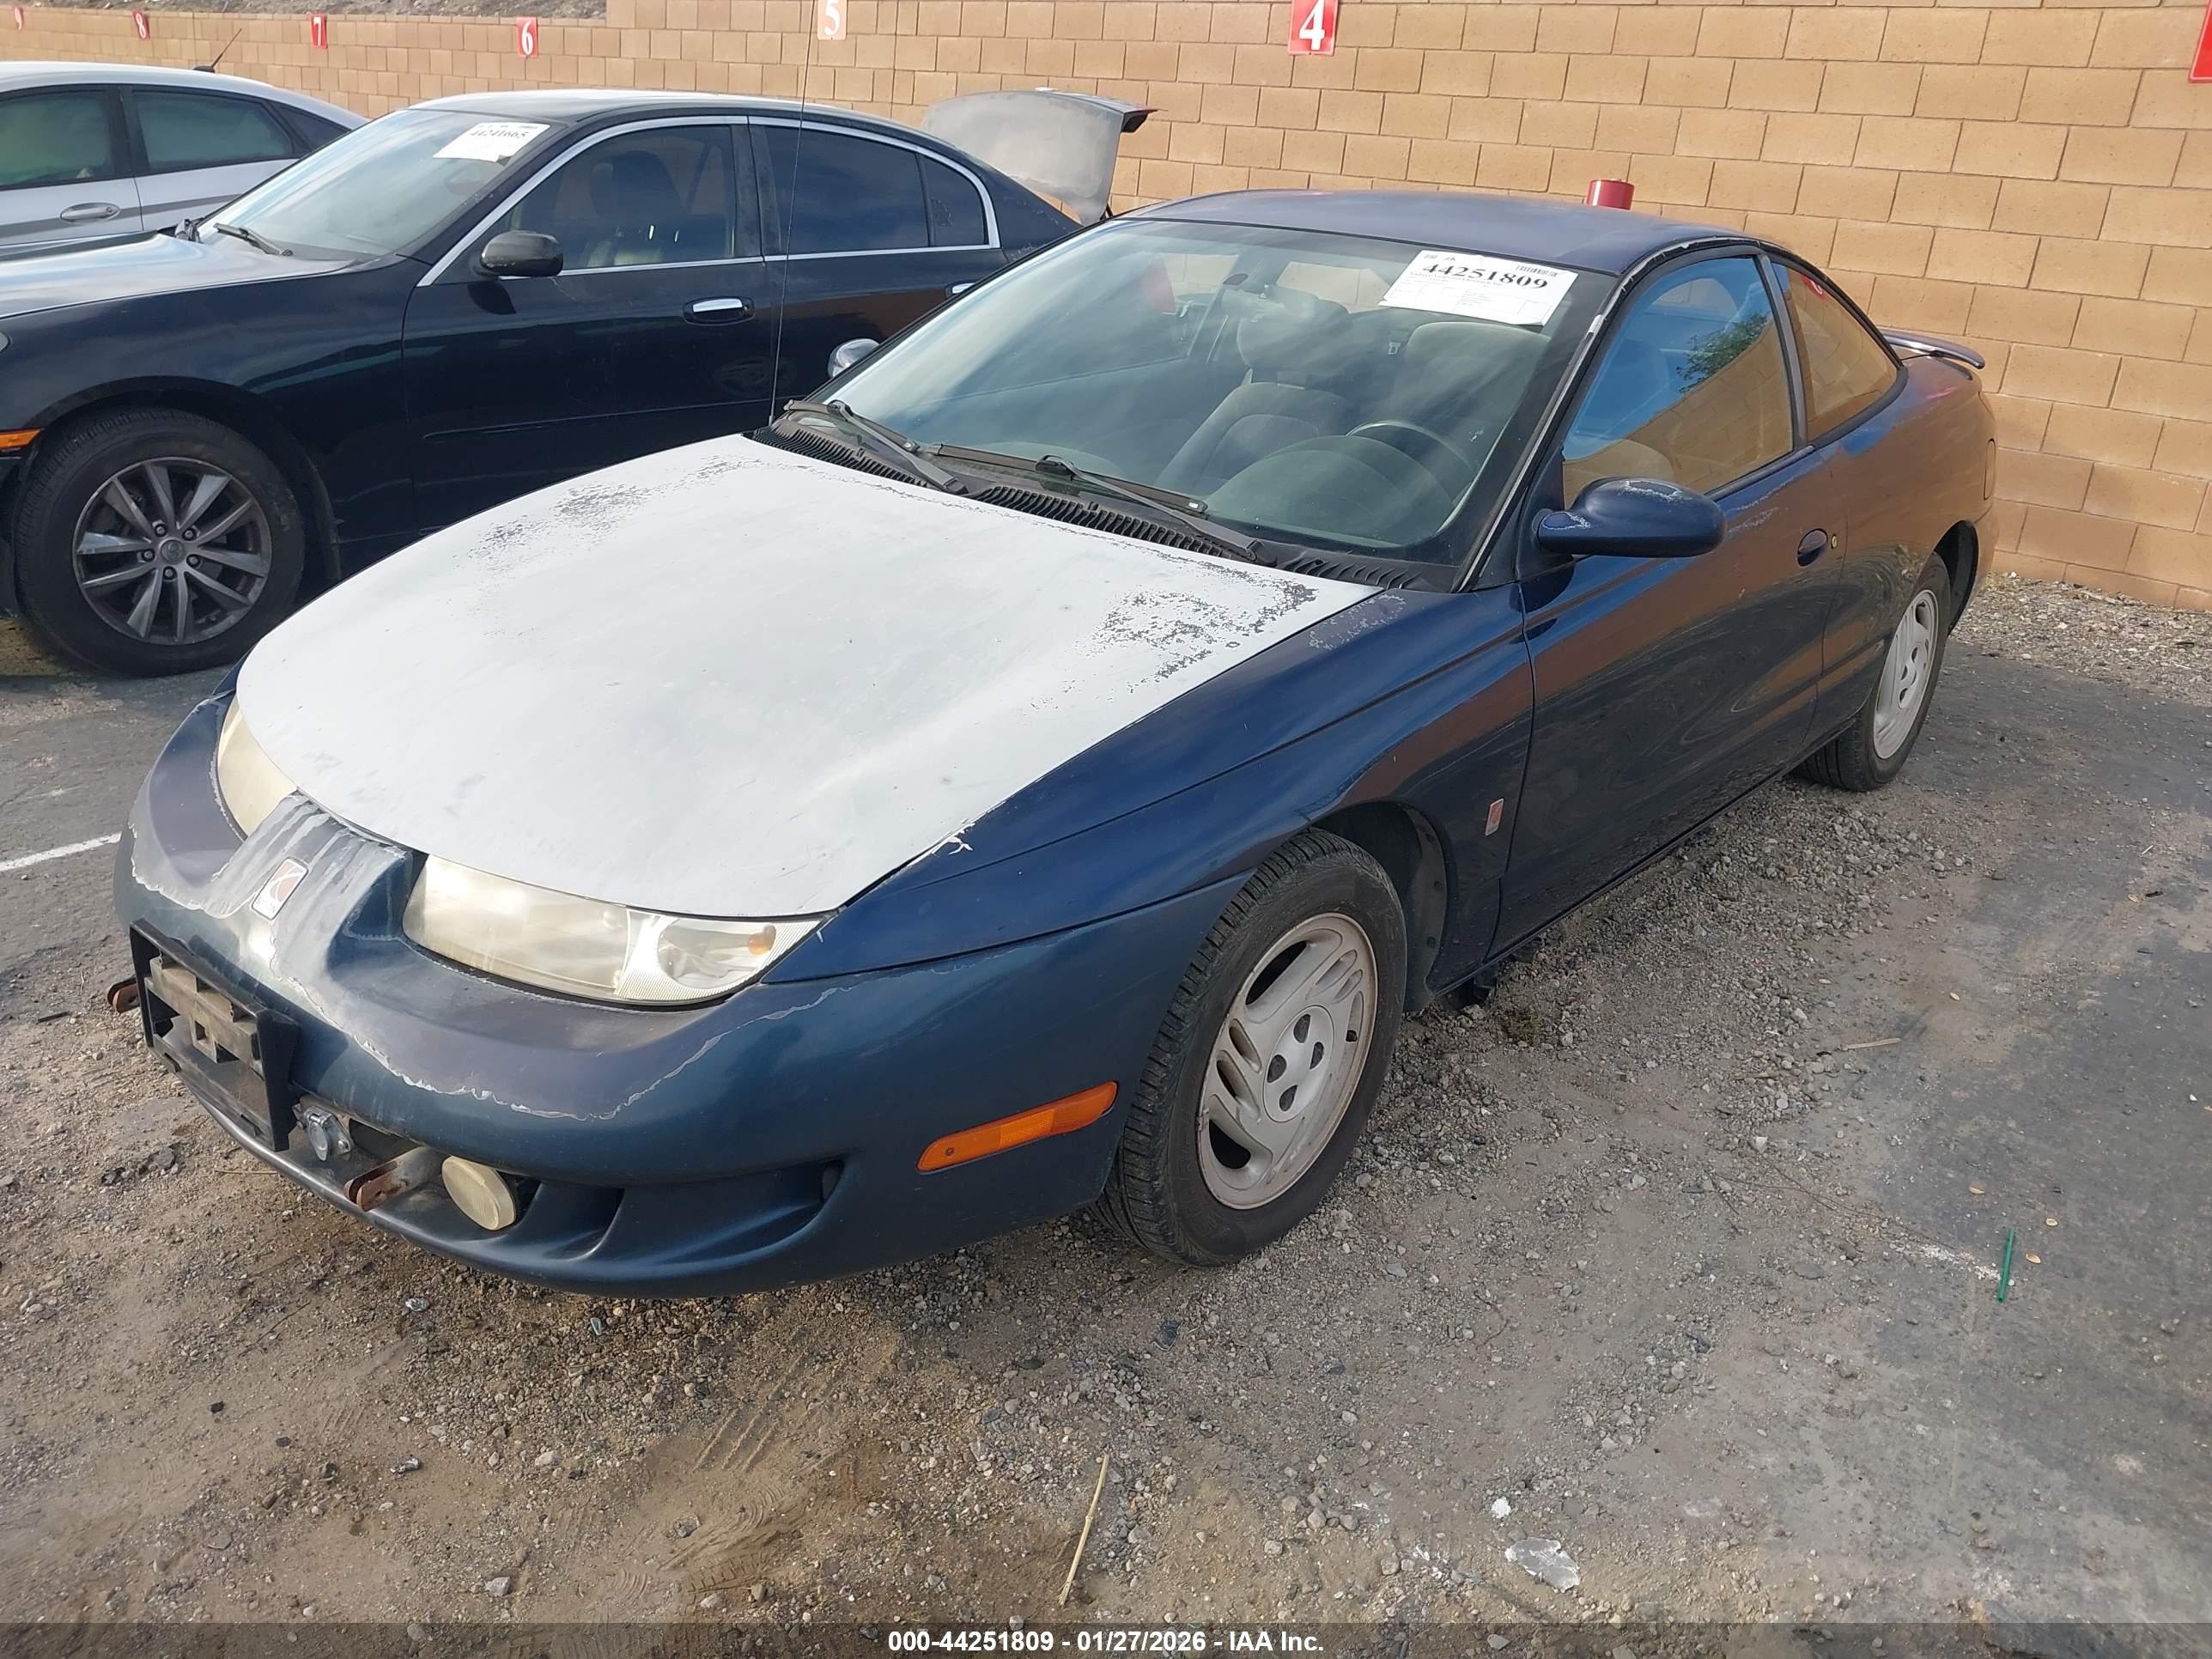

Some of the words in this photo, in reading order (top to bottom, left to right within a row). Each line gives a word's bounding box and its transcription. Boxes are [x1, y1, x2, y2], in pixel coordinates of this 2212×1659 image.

[135, 12, 147, 39] 8
[313, 16, 322, 46] 7
[823, 0, 841, 36] 5
[1298, 0, 1326, 51] 4
[521, 20, 533, 55] 6
[1422, 262, 1549, 290] 44251809
